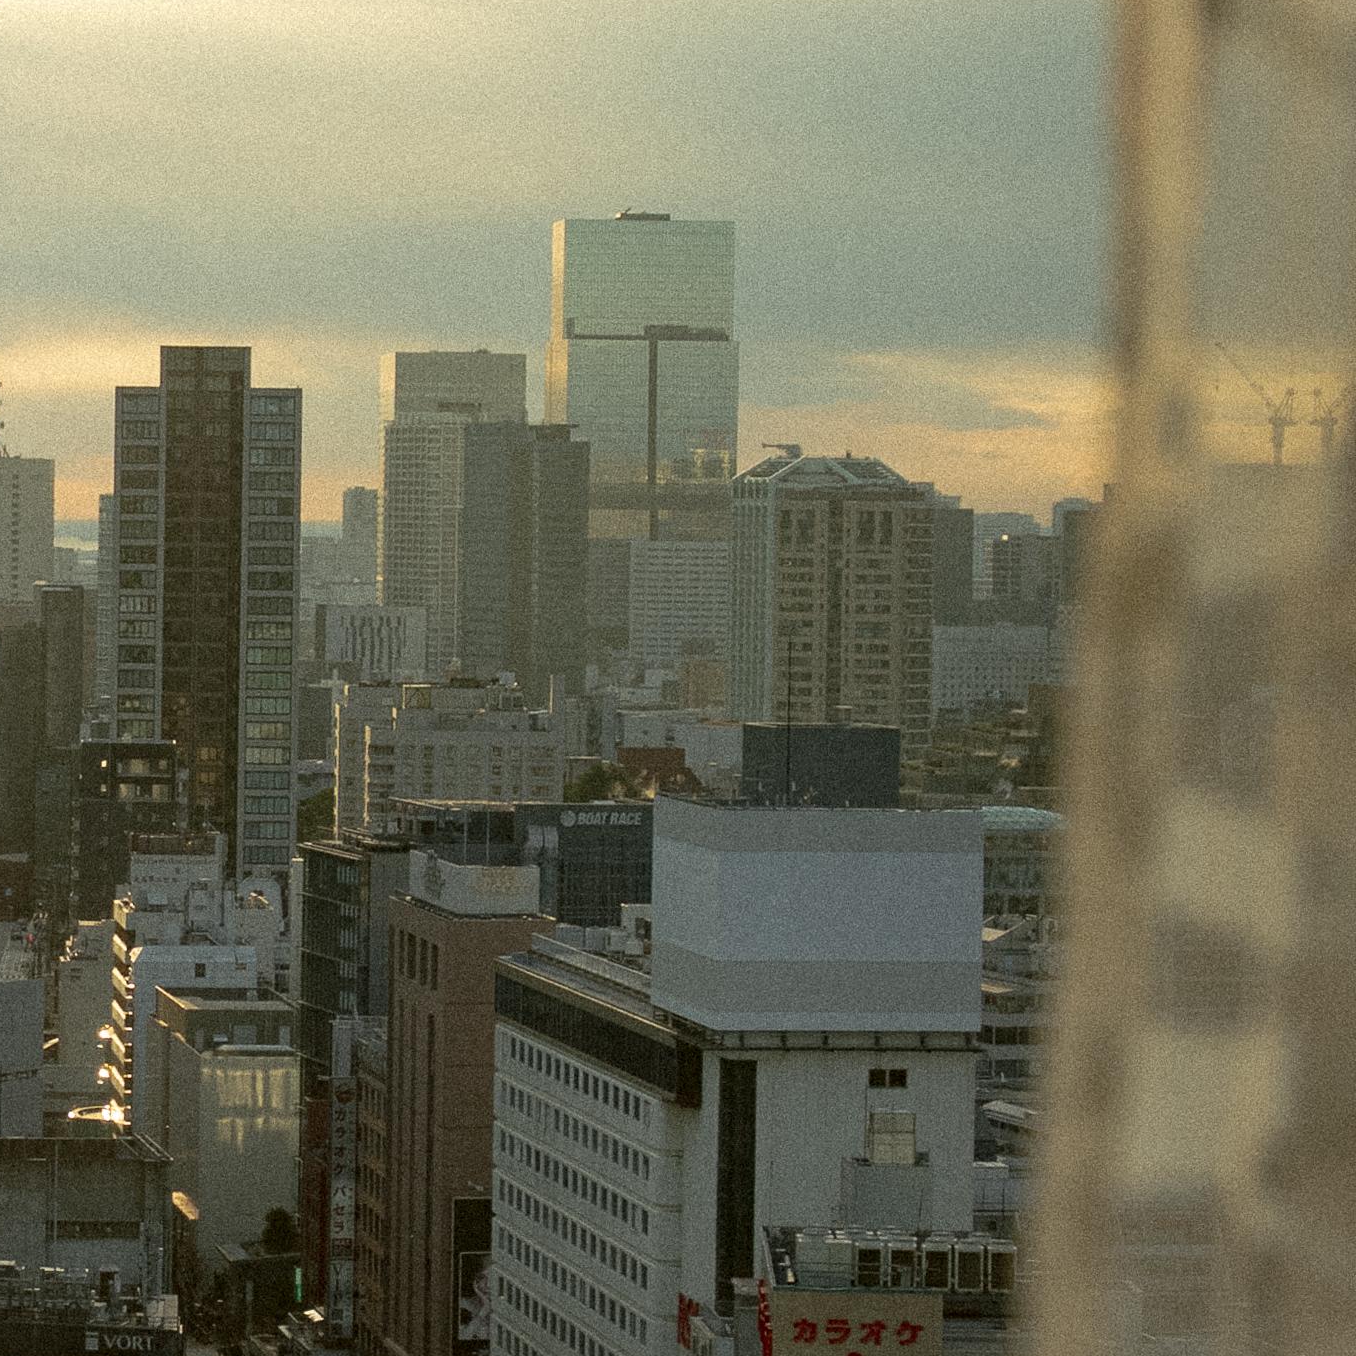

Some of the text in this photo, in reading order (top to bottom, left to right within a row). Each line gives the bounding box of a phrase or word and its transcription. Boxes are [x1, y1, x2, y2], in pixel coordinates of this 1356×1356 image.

[577, 812, 642, 825] BOAT RACE
[794, 1319, 924, 1345] カラオケ
[103, 1335, 154, 1351] VORT
